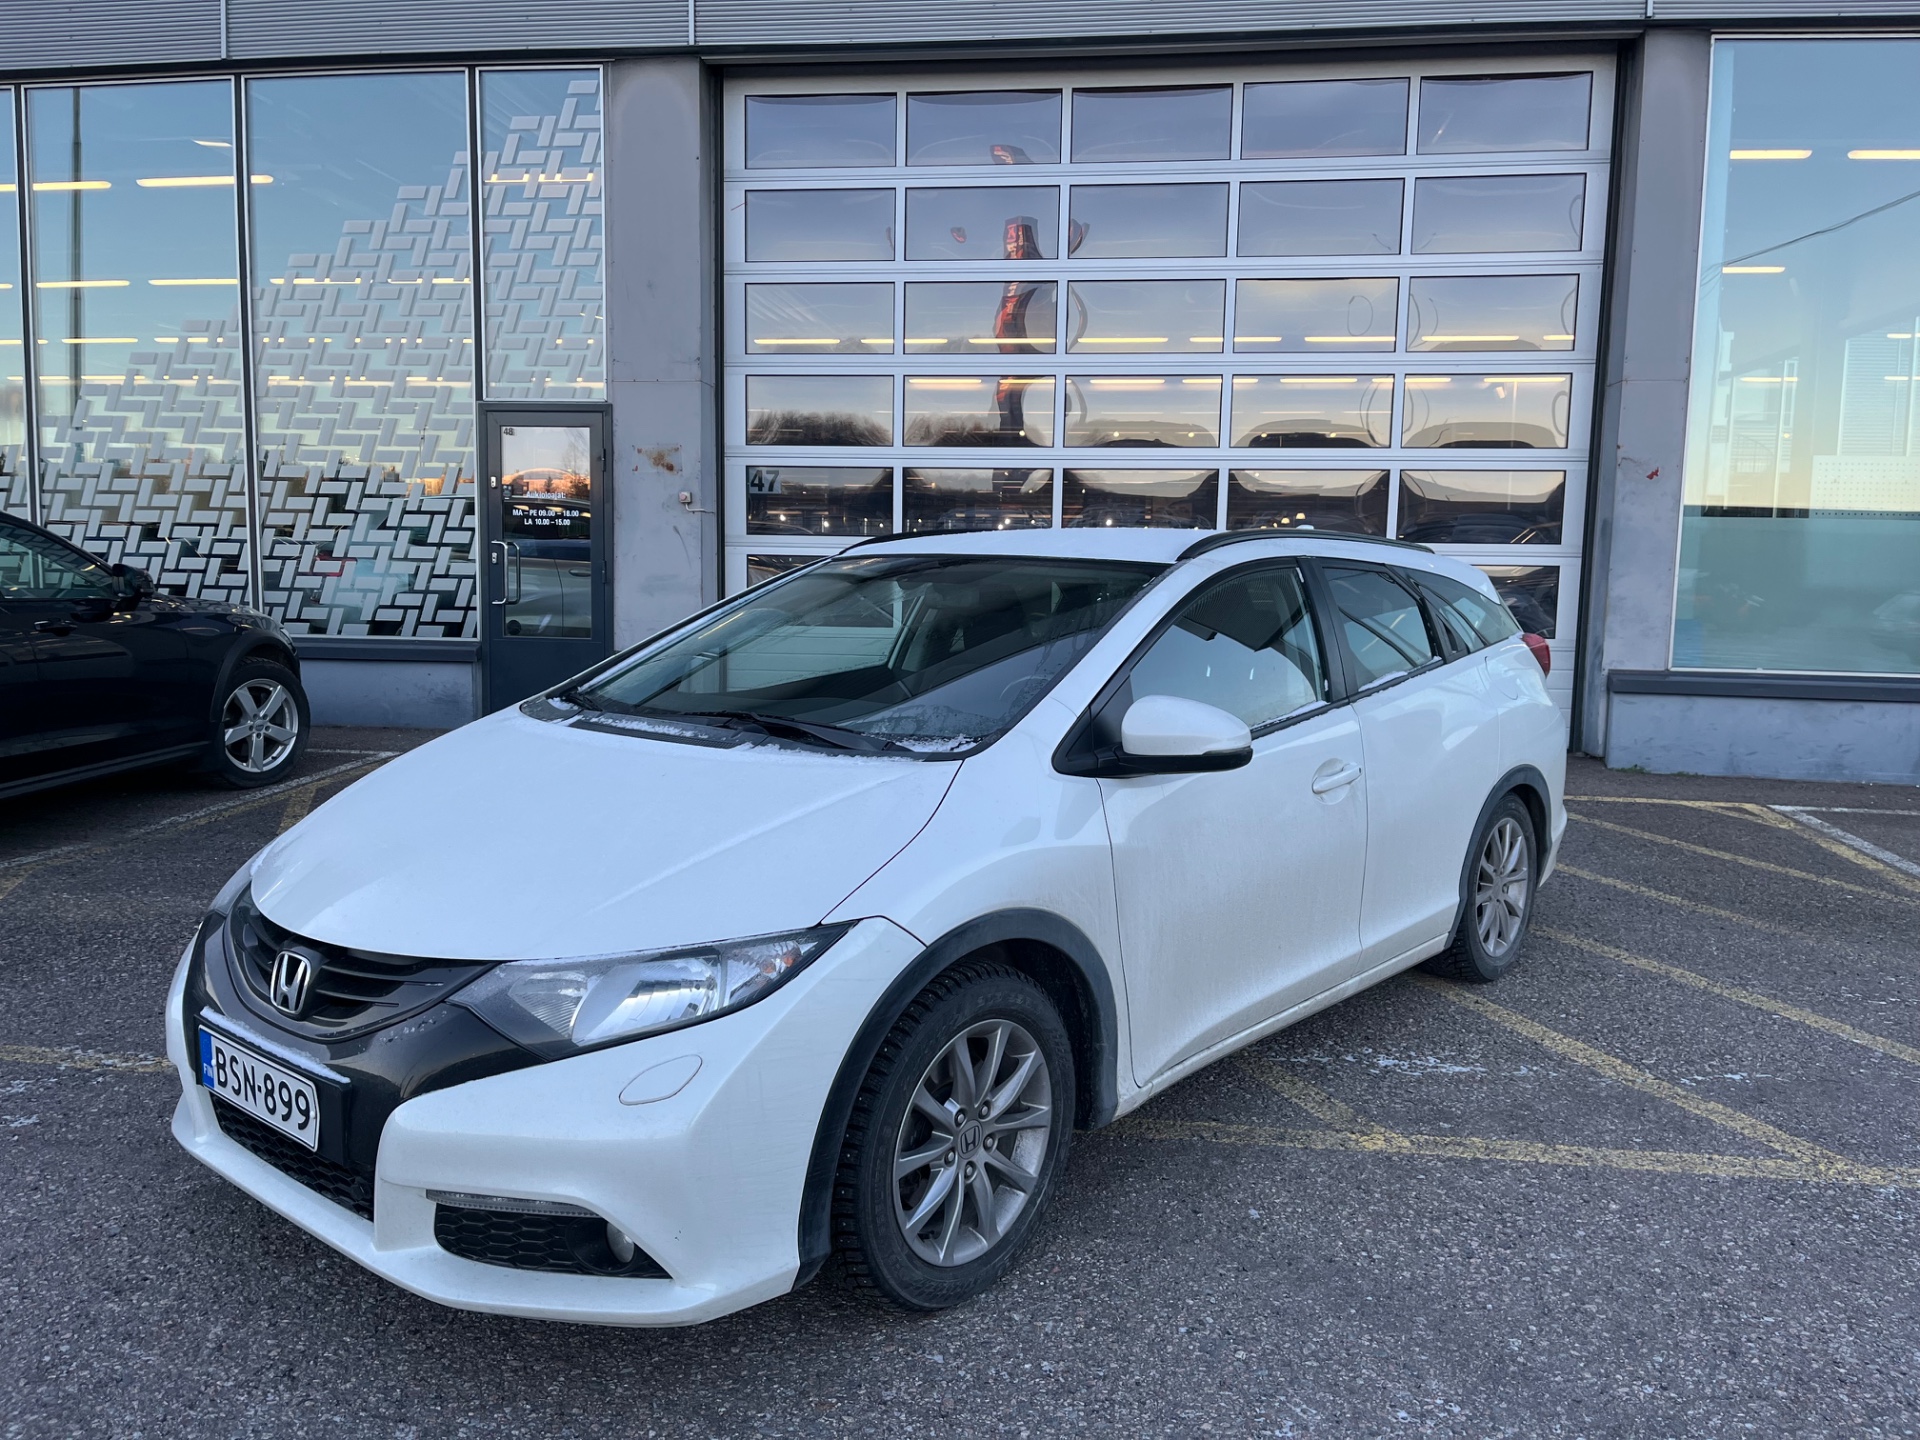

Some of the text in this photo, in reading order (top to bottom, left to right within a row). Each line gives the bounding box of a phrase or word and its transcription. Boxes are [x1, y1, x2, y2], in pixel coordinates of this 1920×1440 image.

[503, 427, 514, 436] 48
[750, 469, 780, 492] 47
[538, 509, 555, 517] 09.00
[535, 518, 550, 526] 10.00
[203, 1062, 214, 1079] FIN
[215, 1045, 310, 1131] BSN-899
